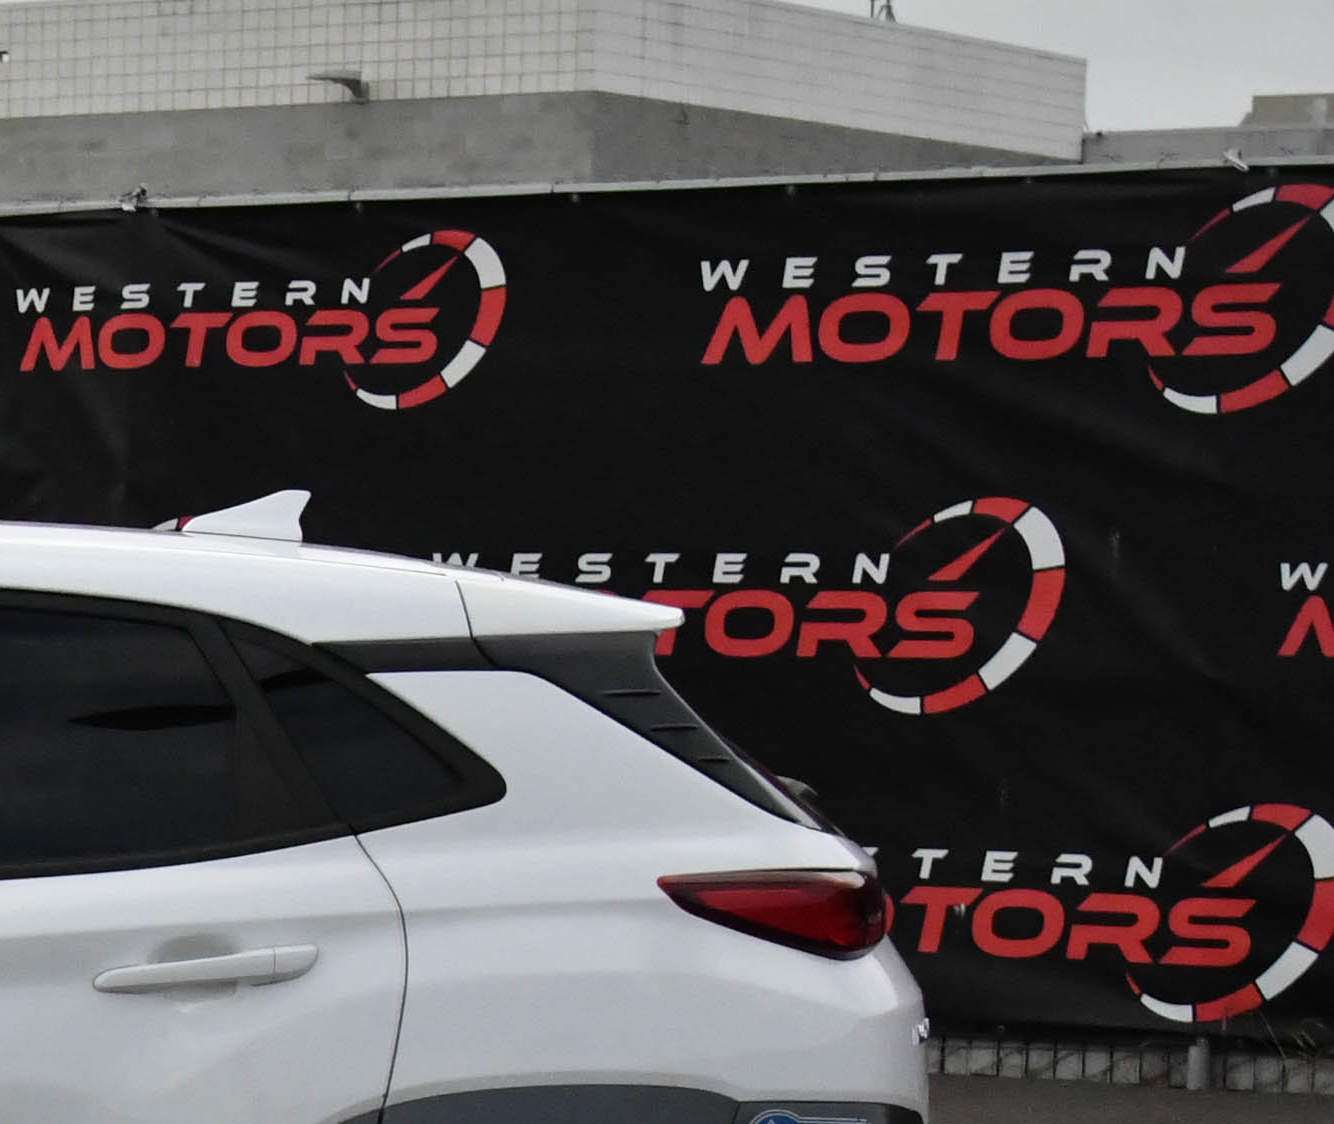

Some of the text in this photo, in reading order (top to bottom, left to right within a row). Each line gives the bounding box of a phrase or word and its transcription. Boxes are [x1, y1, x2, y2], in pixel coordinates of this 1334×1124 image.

[17, 278, 369, 313] WESTERN
[701, 247, 1185, 291] WESTERN
[21, 307, 439, 371] MOTORS
[702, 283, 1280, 365] MOTORS
[644, 589, 979, 659] TORS
[913, 849, 1162, 887] TERN
[900, 885, 1255, 966] TORS
